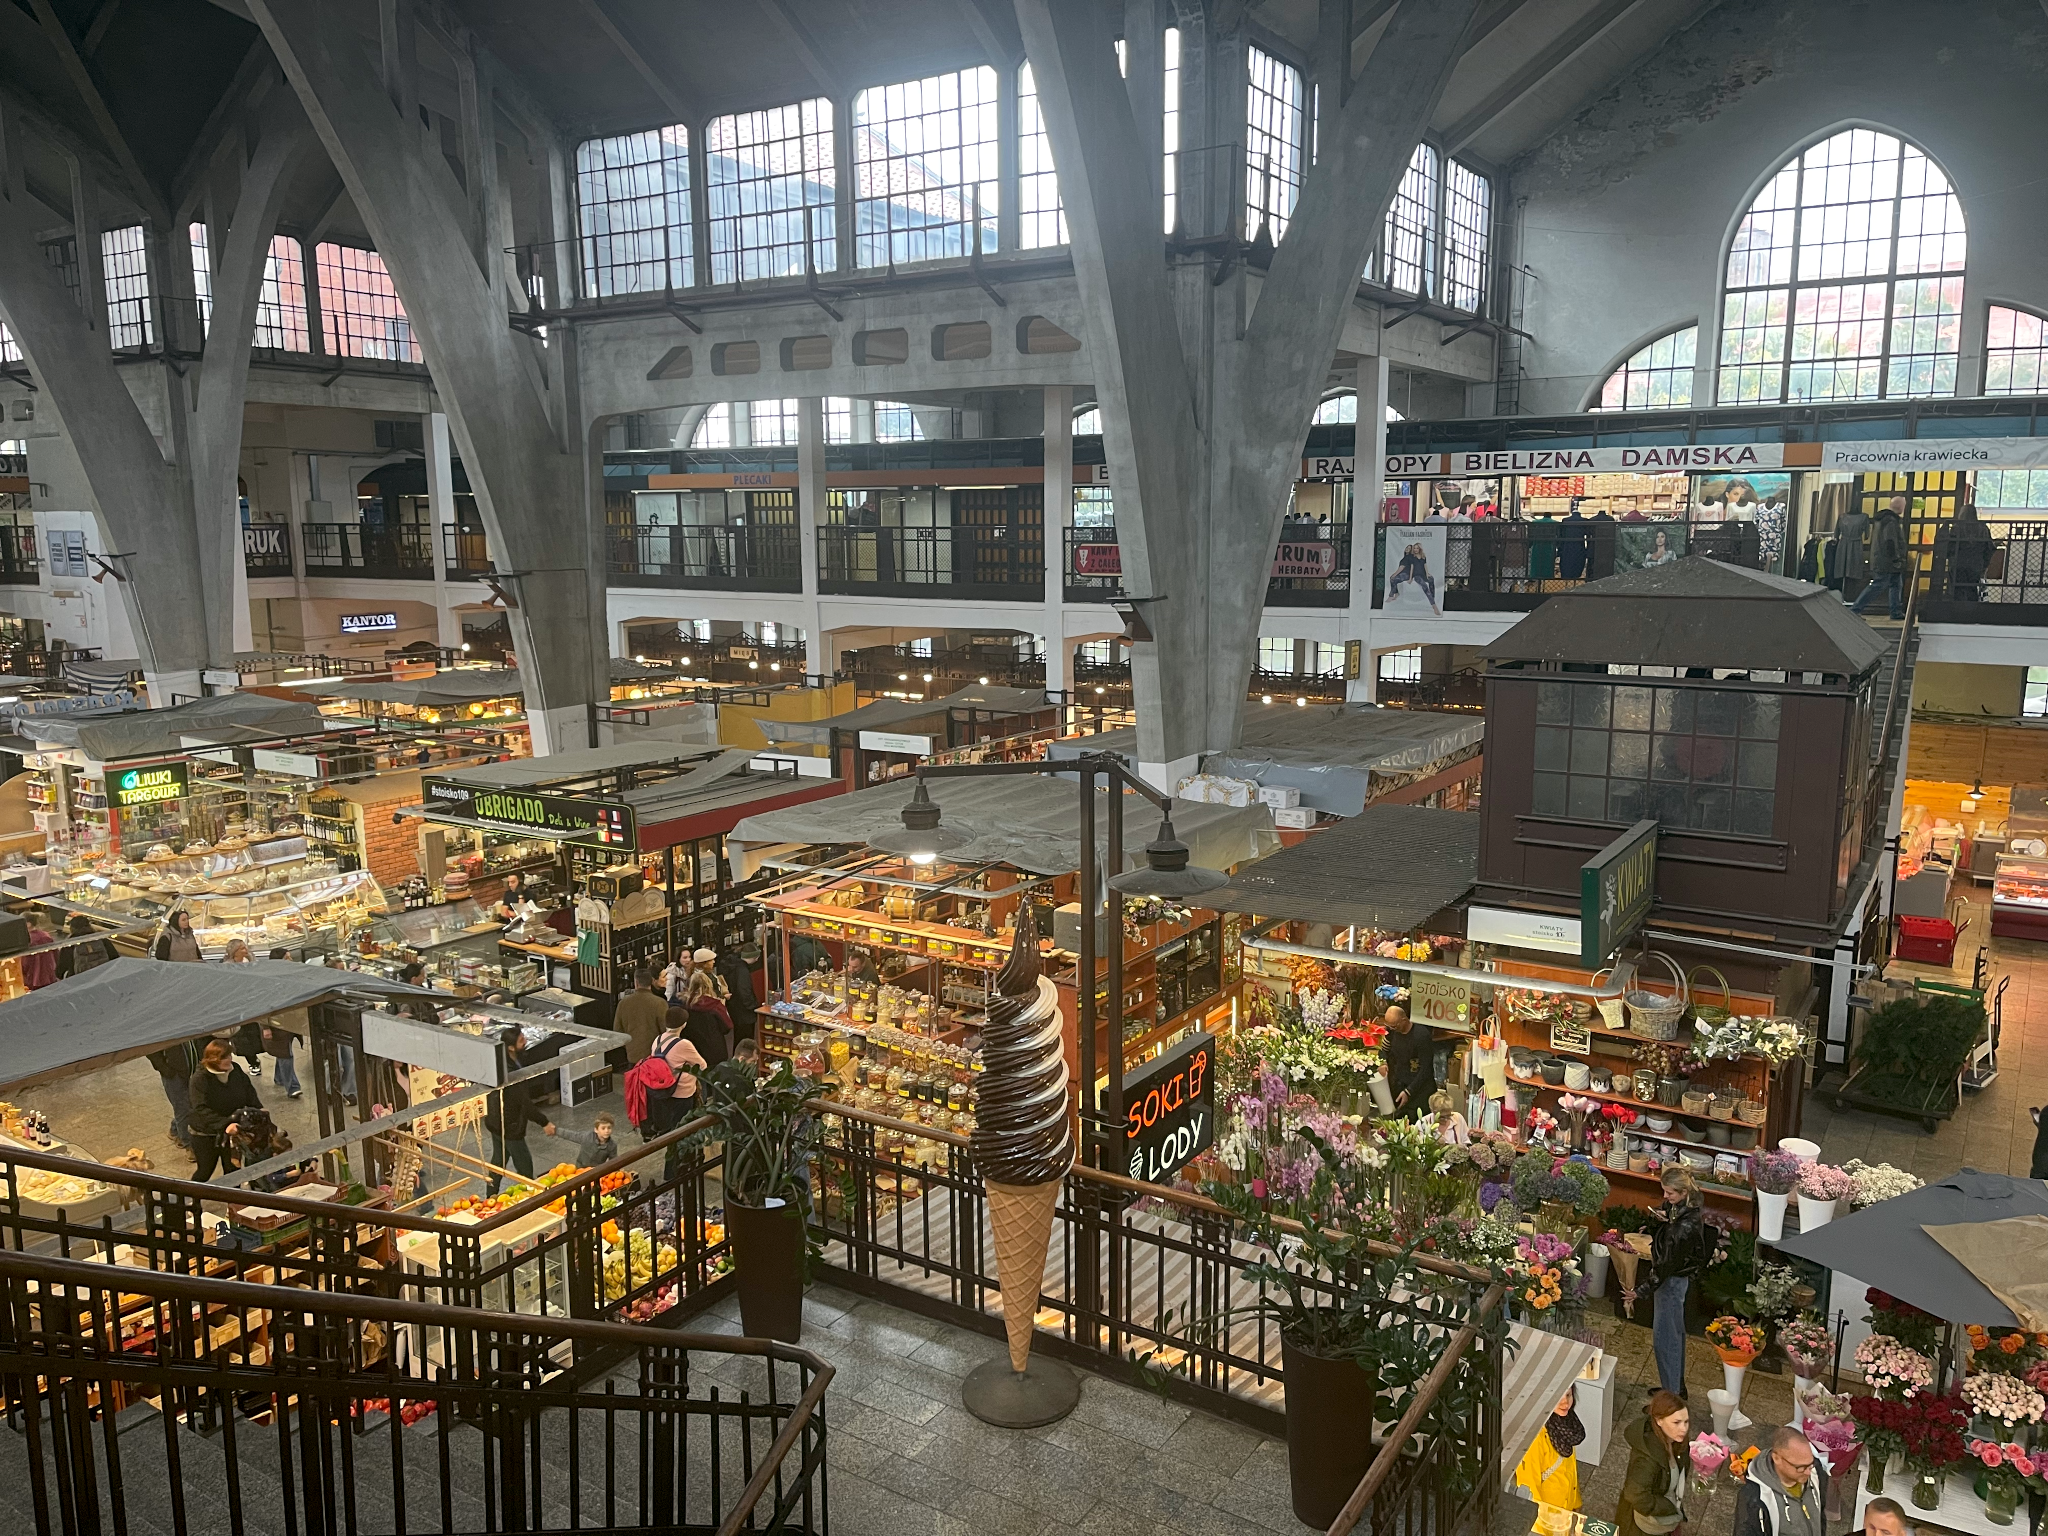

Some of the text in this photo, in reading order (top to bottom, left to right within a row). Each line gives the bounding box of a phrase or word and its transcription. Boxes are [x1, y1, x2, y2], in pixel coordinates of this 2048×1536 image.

[1316, 456, 1433, 475] RAJOPY
[1465, 446, 1758, 471] BIELIZNA DAMSKA
[1835, 448, 1988, 463] Pracownia krawiecka
[733, 474, 771, 485] PLECAKI
[243, 530, 281, 554] RUK
[1274, 544, 1320, 565] TRUM
[1278, 565, 1321, 575] HERBATY
[341, 613, 396, 628] KANTOR
[121, 769, 173, 790] OLIWKI
[119, 784, 181, 805] TARGOWA
[431, 784, 469, 801] #stoisko109
[474, 791, 546, 824] OBRIGADO
[1617, 836, 1656, 917] KWIATY
[1539, 924, 1564, 932] KWIATY
[1422, 998, 1458, 1022] 106
[1127, 1072, 1185, 1139] SOKI
[1148, 1112, 1204, 1182] LODY
